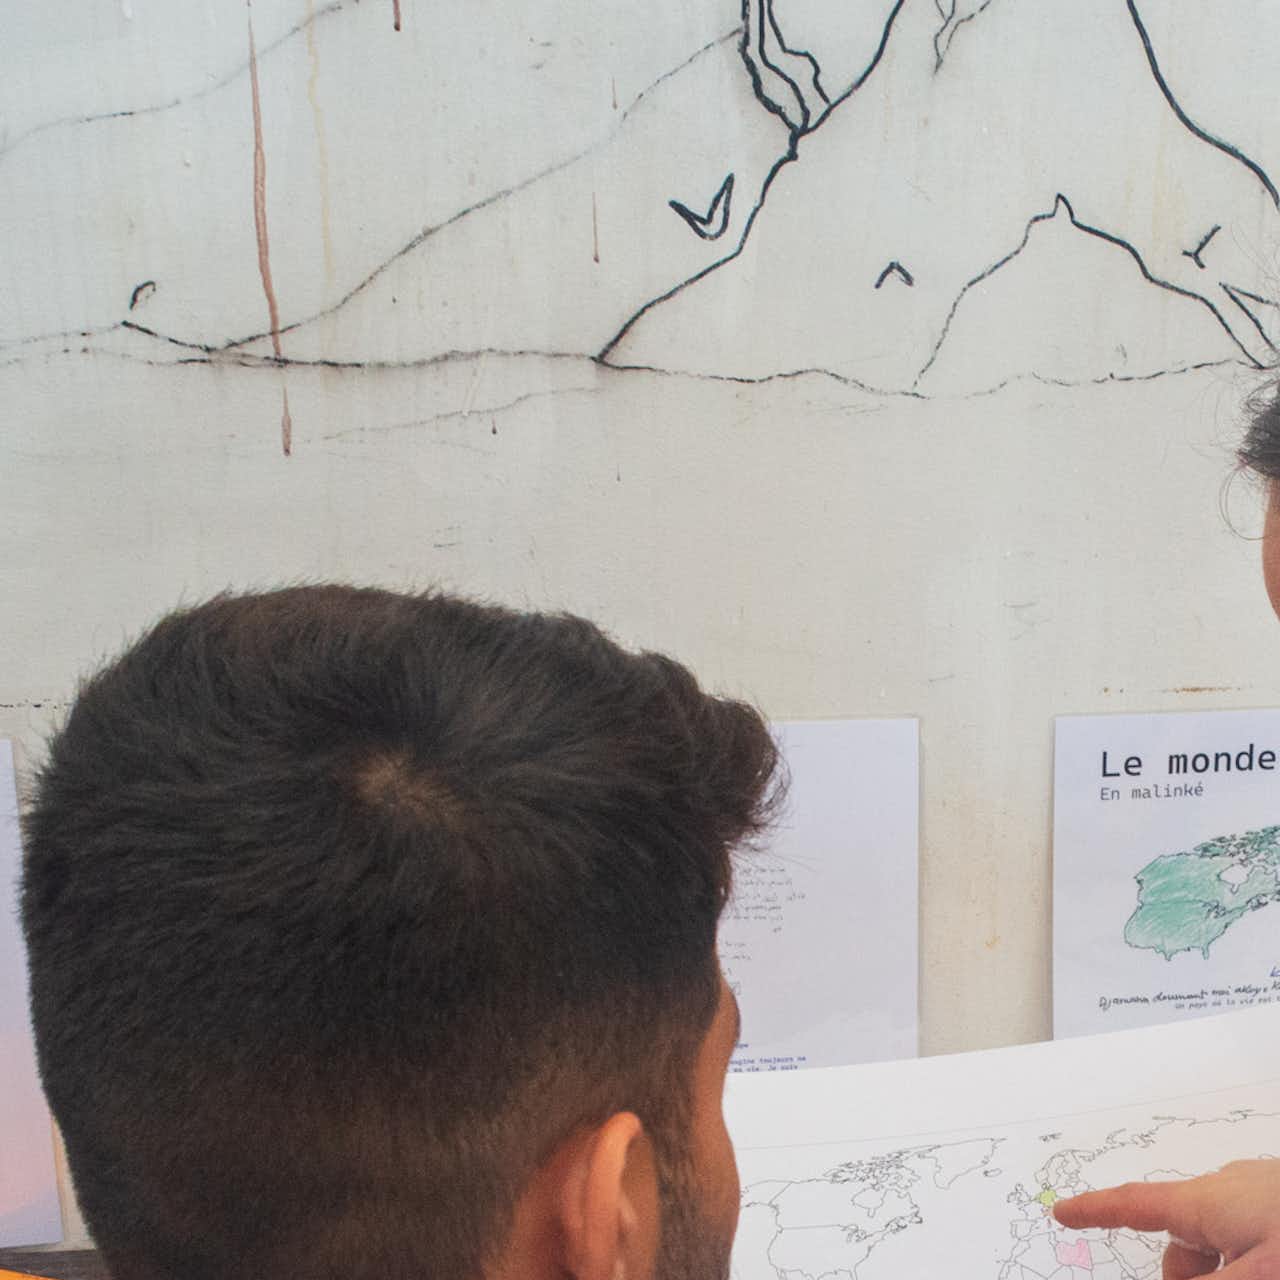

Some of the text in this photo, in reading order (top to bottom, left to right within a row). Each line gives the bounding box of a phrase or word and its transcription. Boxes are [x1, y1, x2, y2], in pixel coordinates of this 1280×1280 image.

[1101, 751, 1143, 778] Le
[1167, 743, 1277, 775] monde
[1100, 781, 1204, 801] En malinké
